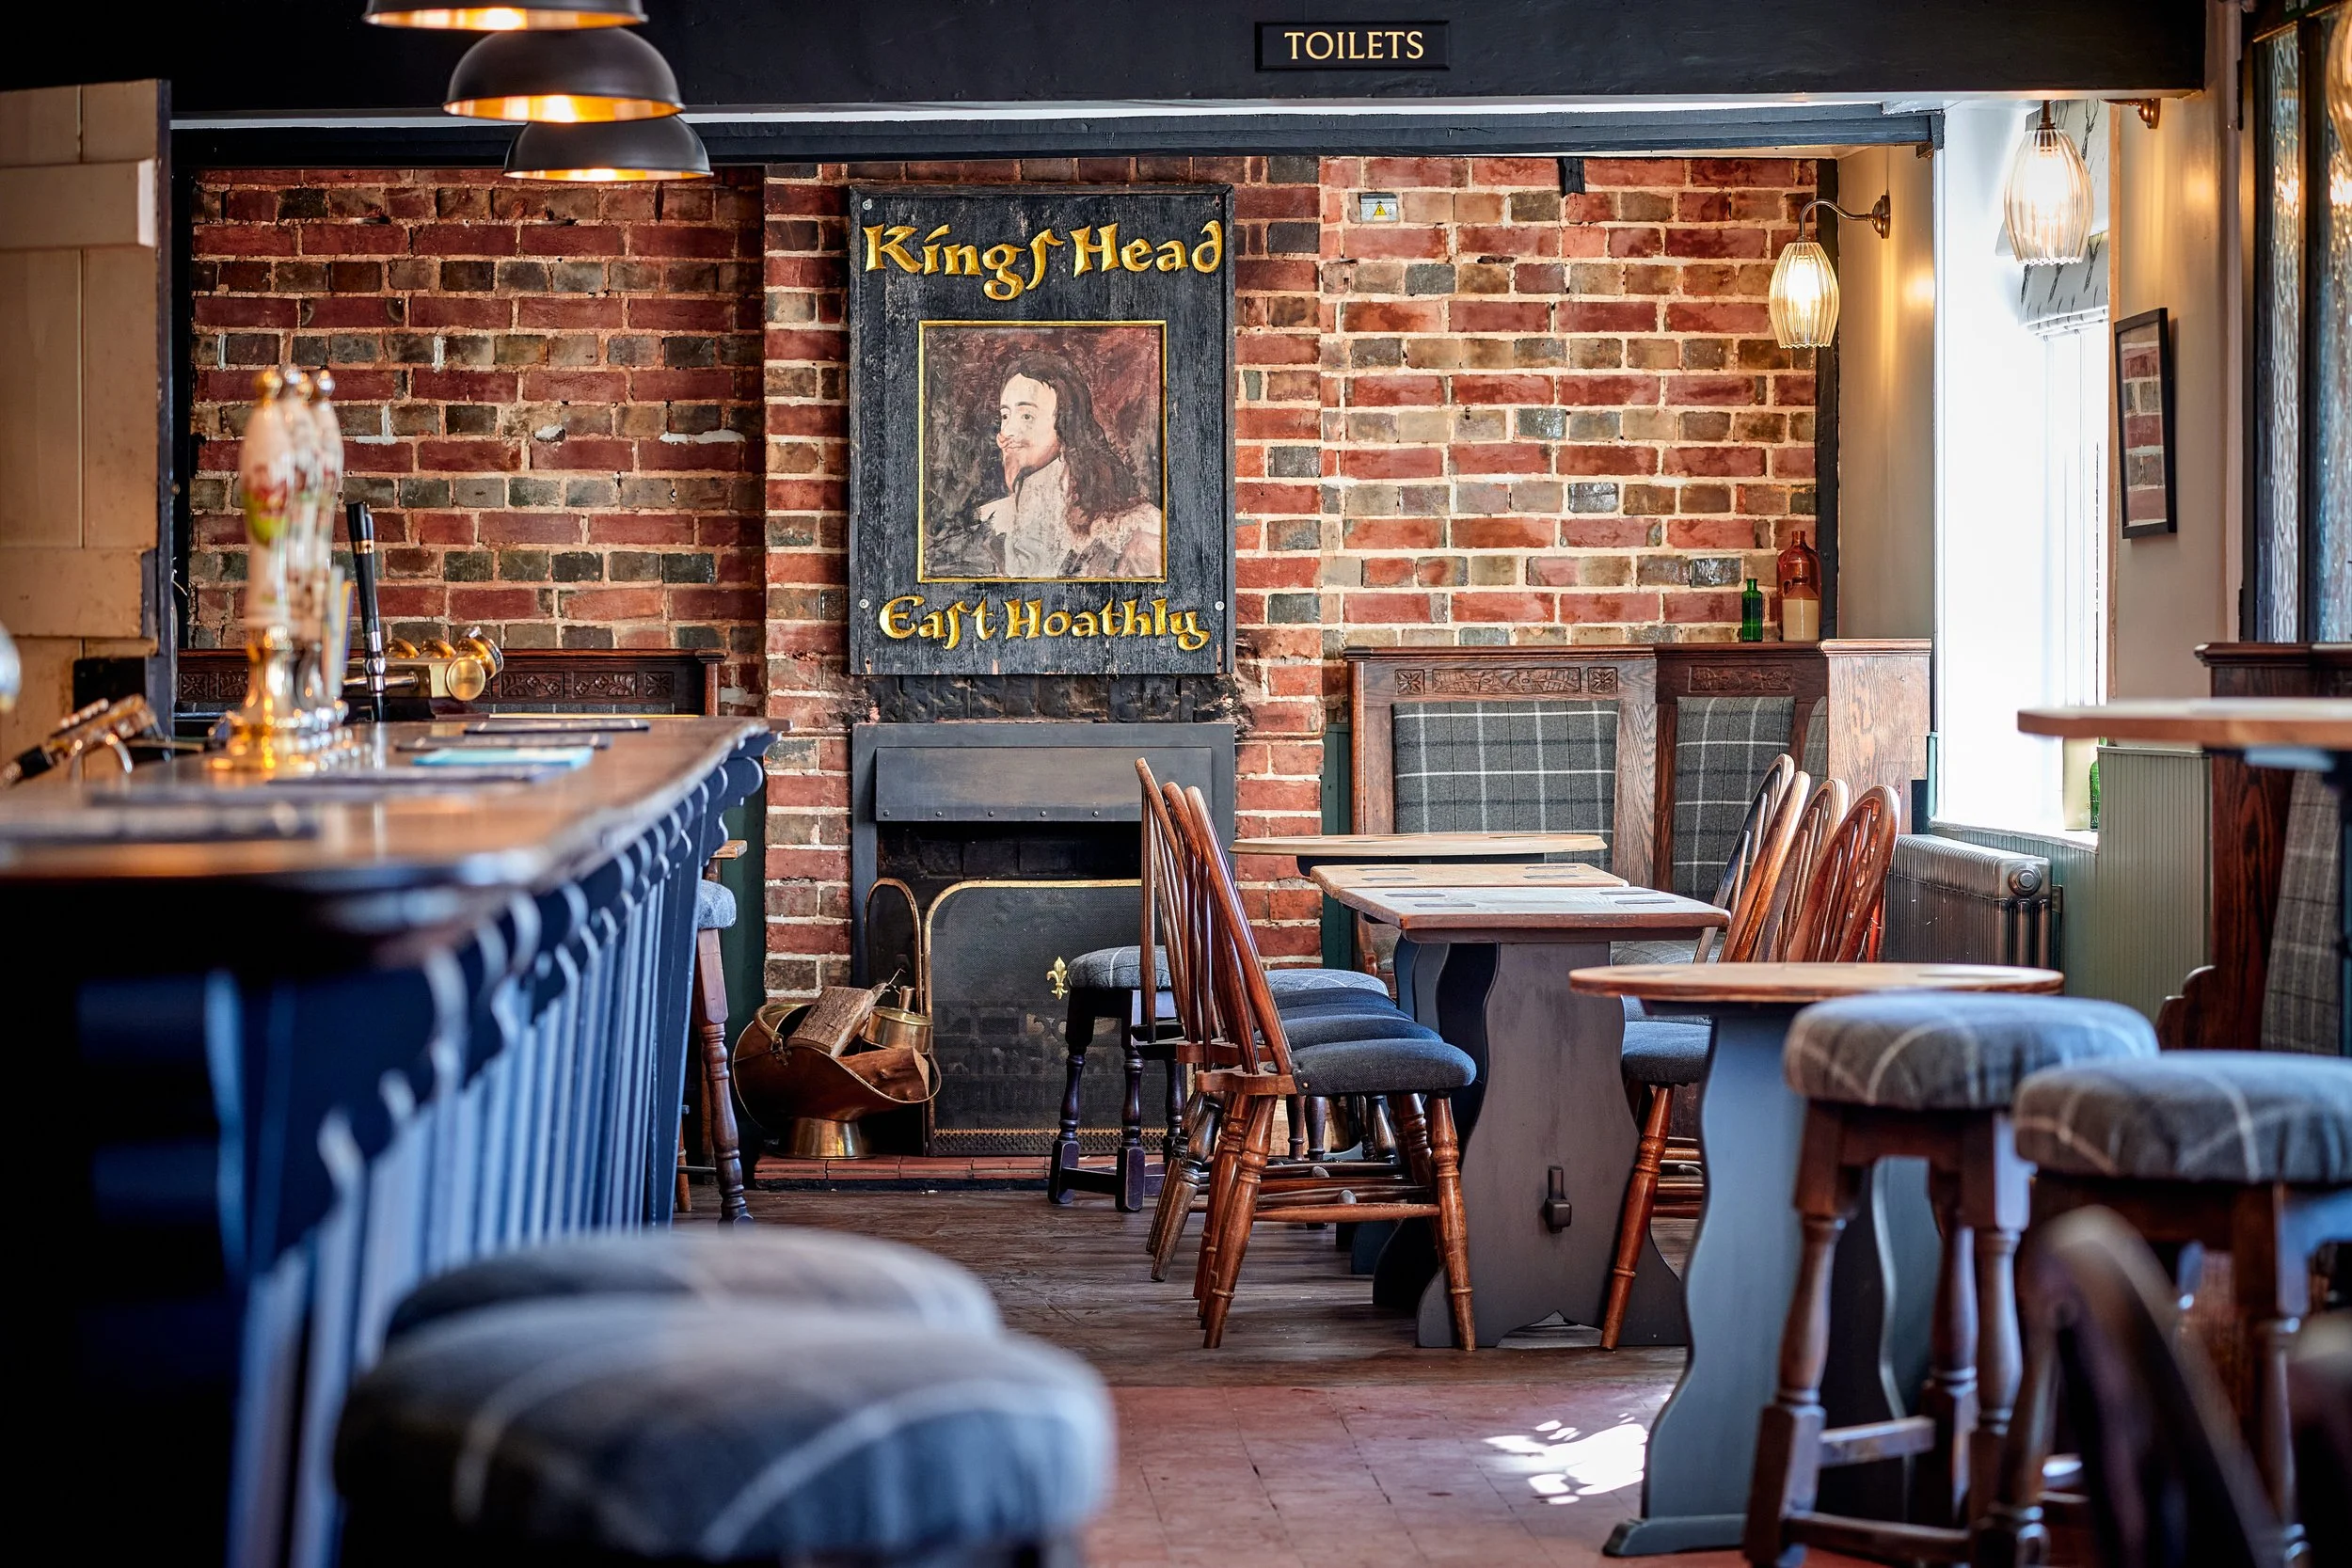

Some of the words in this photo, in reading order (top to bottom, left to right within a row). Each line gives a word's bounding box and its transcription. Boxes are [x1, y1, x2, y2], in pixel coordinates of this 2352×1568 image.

[1283, 30, 1424, 60] TOILETS
[1069, 219, 1223, 278] Head
[1004, 596, 1212, 652] Hoathly
